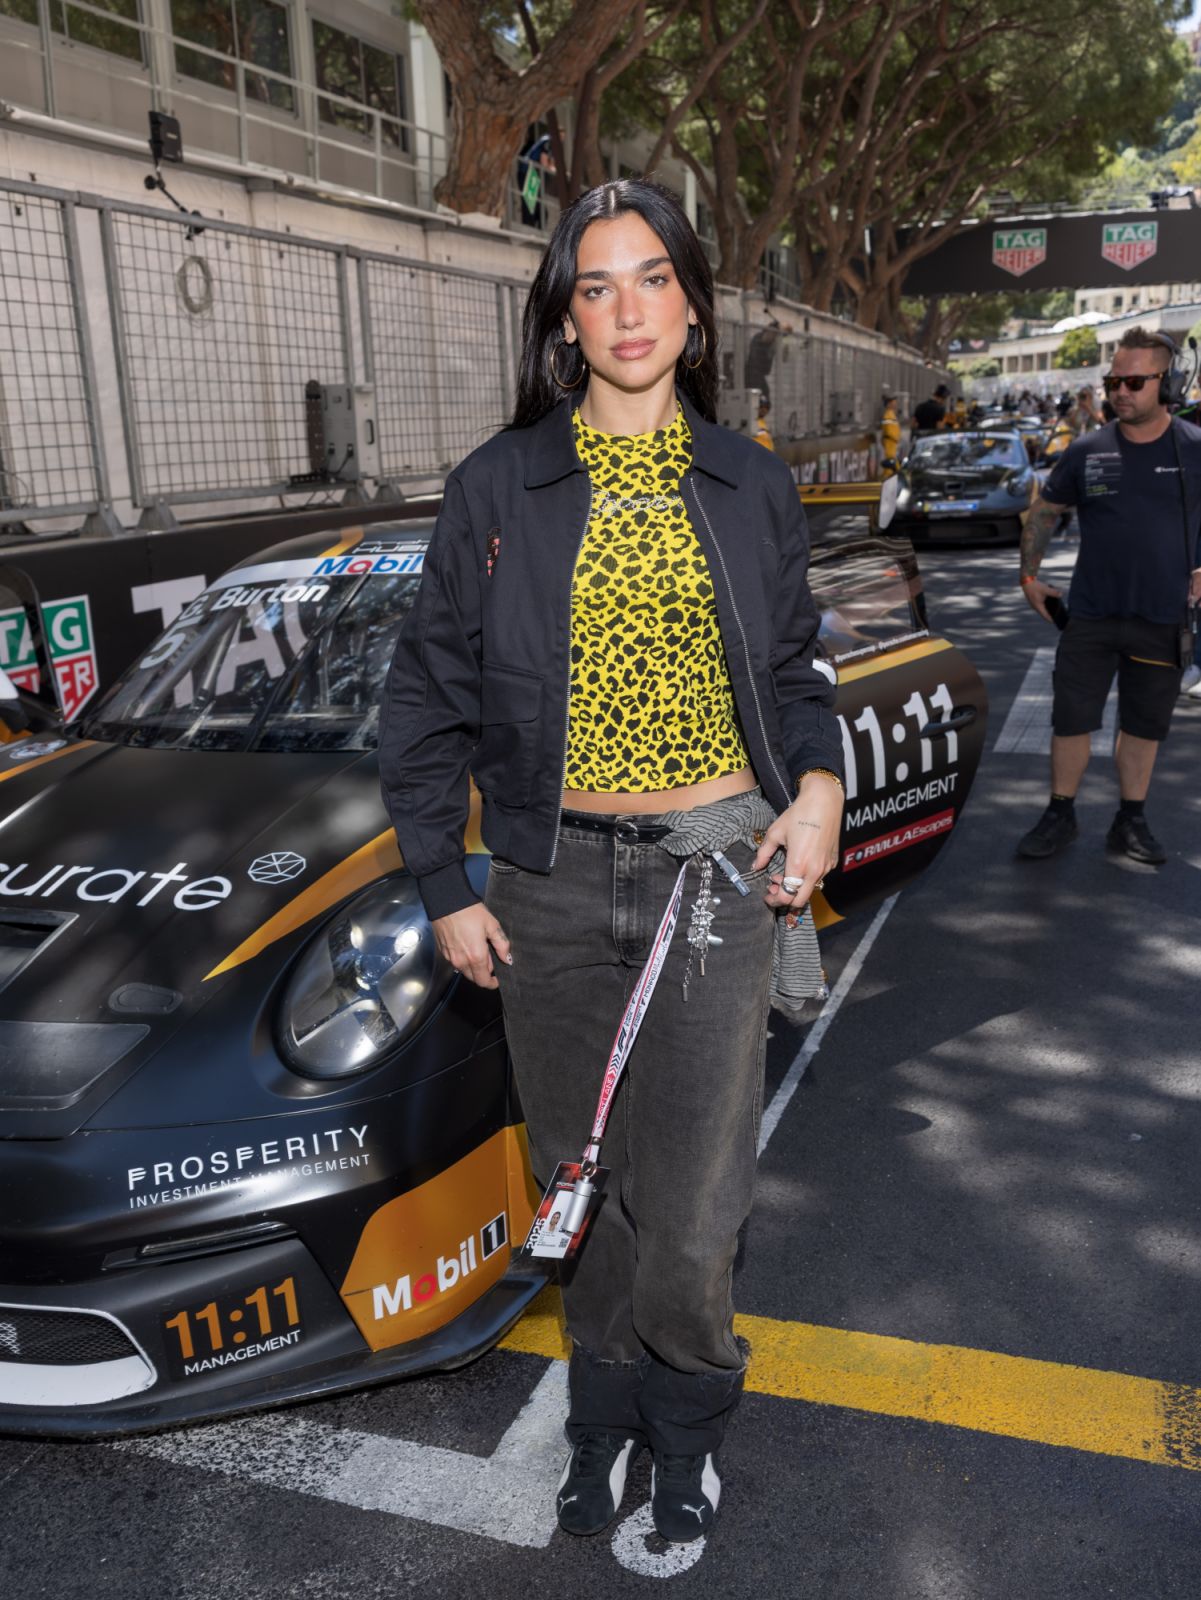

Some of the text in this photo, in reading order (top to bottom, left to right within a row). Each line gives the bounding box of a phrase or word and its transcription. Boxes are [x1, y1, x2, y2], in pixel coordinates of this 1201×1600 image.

[998, 233, 1041, 248] TAG
[1108, 225, 1152, 241] TAG
[312, 555, 425, 576] Mobil
[210, 583, 330, 612] Burton
[139, 615, 205, 670] 5
[836, 683, 958, 800] 11:11
[846, 773, 959, 832] MANAGEMENT
[0, 862, 232, 911] urate
[127, 1125, 369, 1190] PROSPERITY
[129, 1176, 242, 1209] INVESTMENT
[526, 1218, 547, 1250] 2025
[372, 1235, 477, 1320] Mobil
[166, 1276, 300, 1359] 11:11
[184, 1330, 301, 1376] MANAGEMENT
